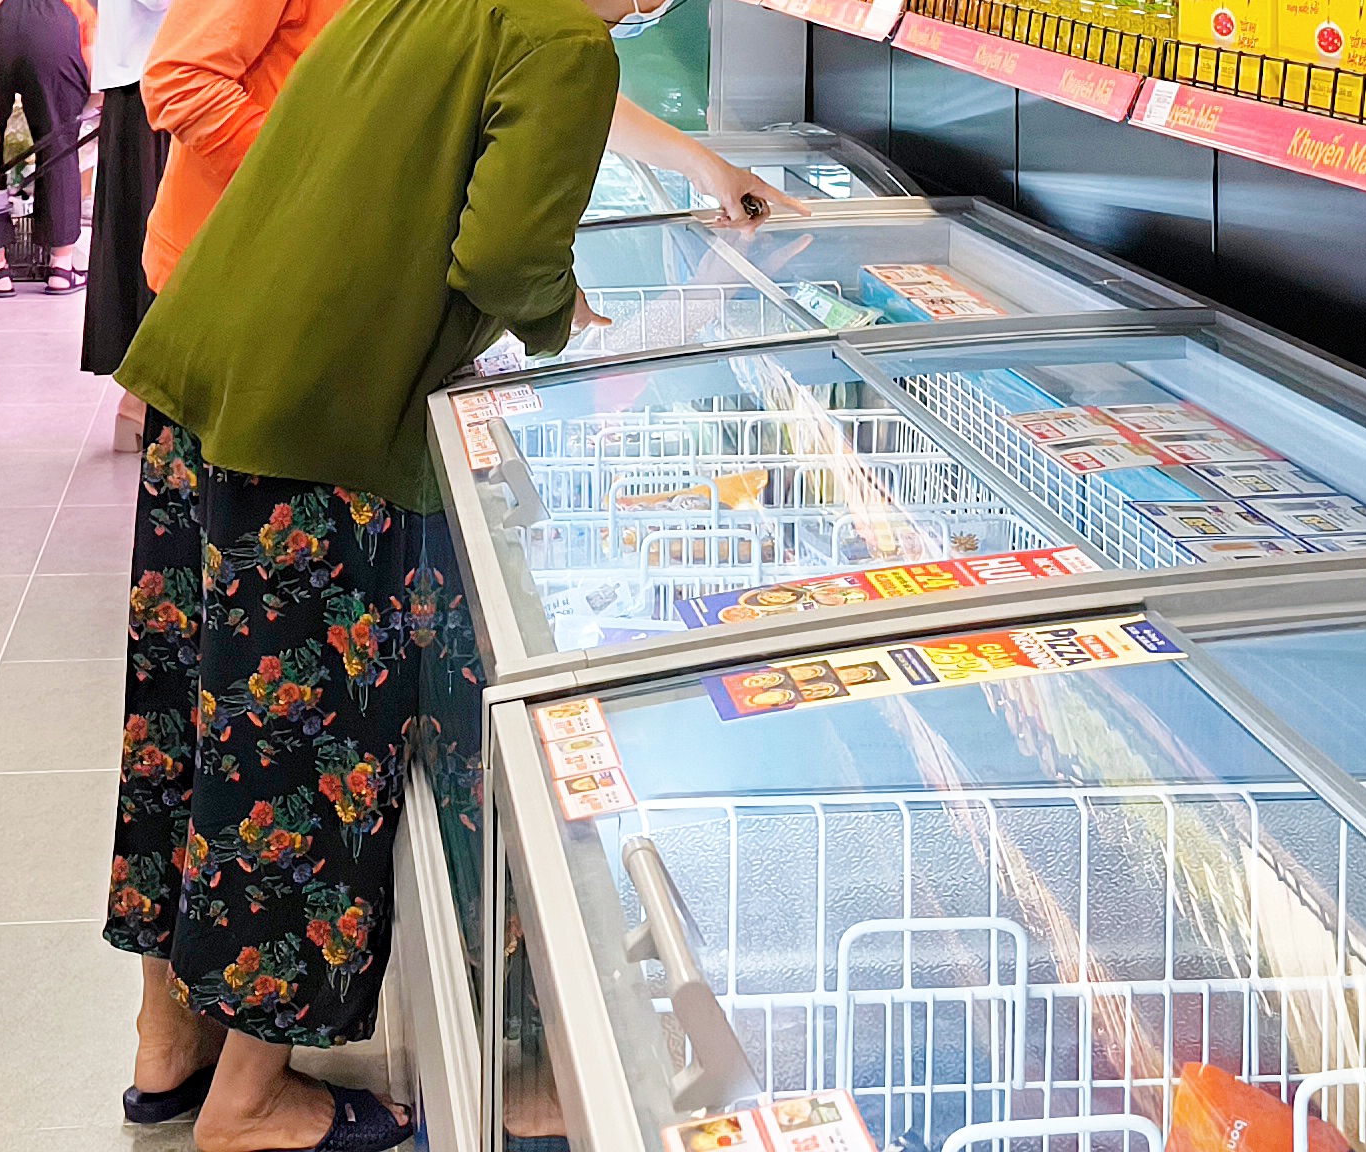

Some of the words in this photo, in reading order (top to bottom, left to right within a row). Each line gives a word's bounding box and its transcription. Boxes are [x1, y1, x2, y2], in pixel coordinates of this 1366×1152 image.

[1287, 125, 1345, 175] Khuyến
[922, 642, 988, 680] 25%
[976, 642, 1018, 669] GIẢM
[1038, 627, 1092, 667] PIZZA
